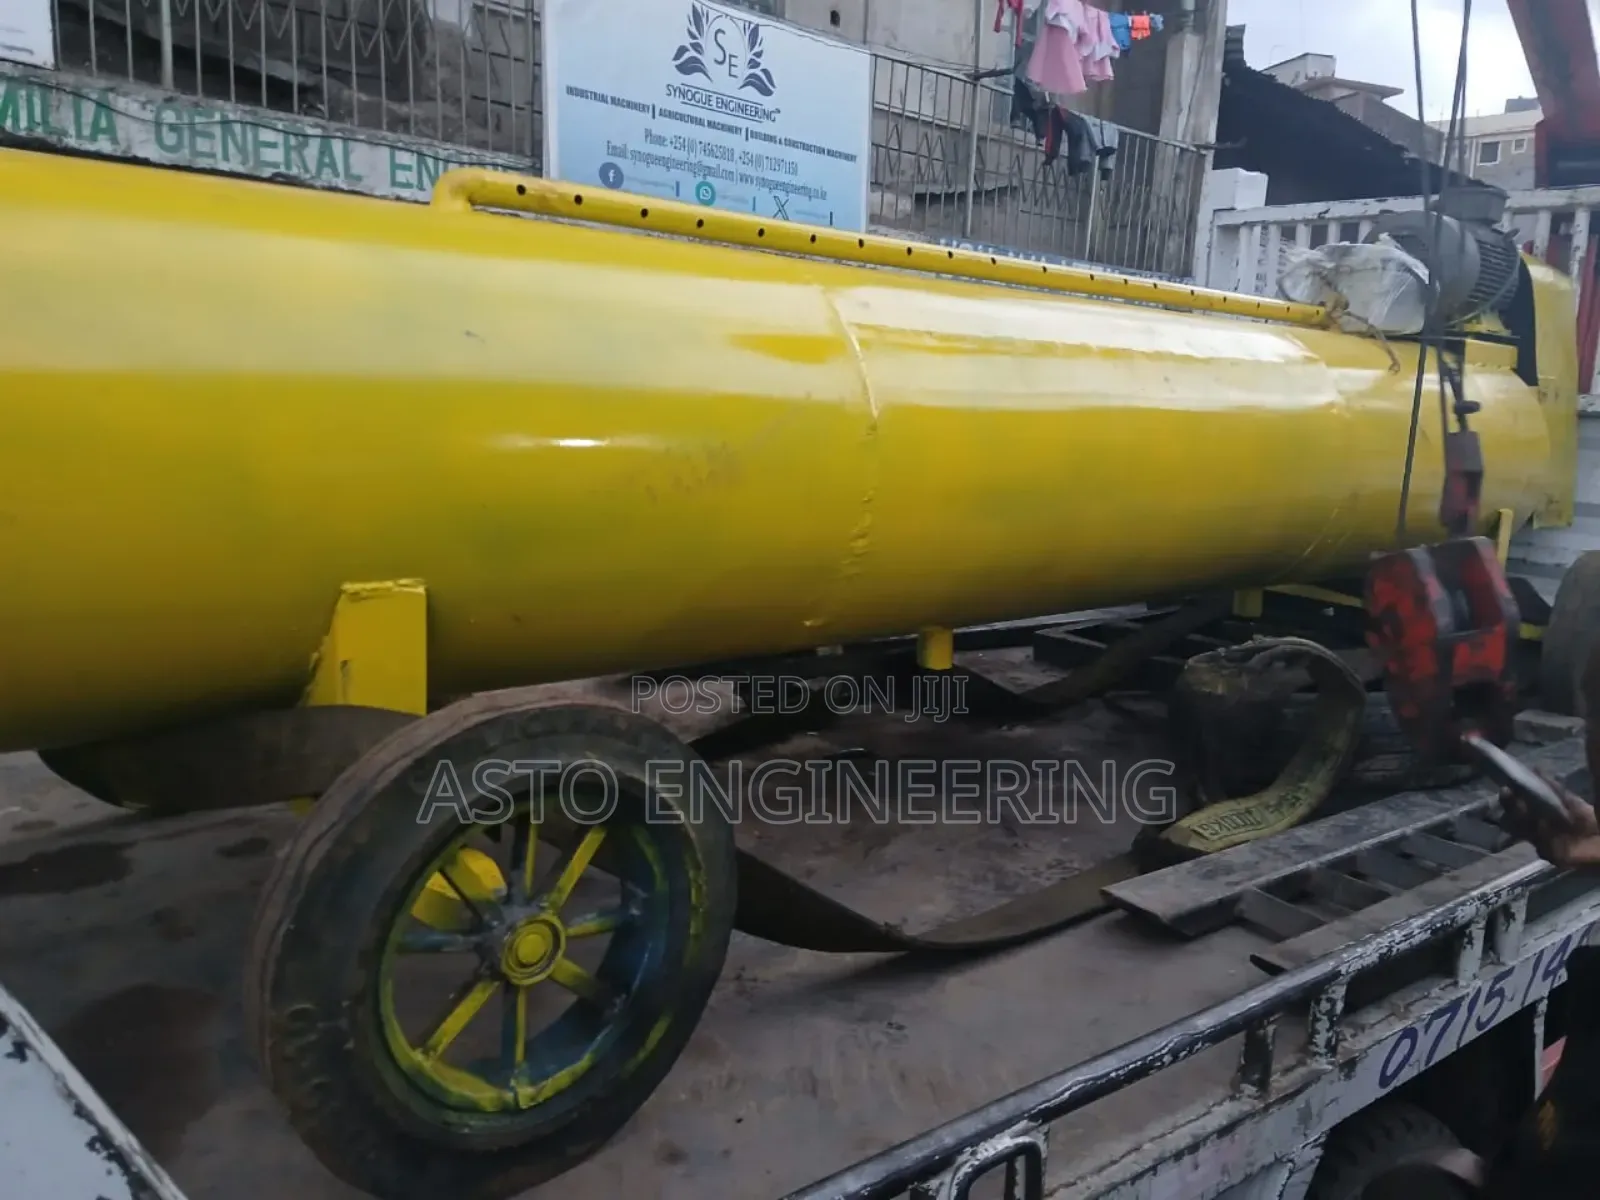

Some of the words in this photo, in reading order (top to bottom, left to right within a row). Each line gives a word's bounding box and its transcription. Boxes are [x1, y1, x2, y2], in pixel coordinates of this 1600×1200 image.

[566, 84, 610, 105] INDUSTRIAL
[610, 95, 651, 115] MACHINERY
[665, 83, 714, 108] SYNOGUE
[658, 107, 706, 128] AGRICULTURAL
[706, 120, 743, 137] MACHINERY
[155, 102, 363, 184] GENERAL
